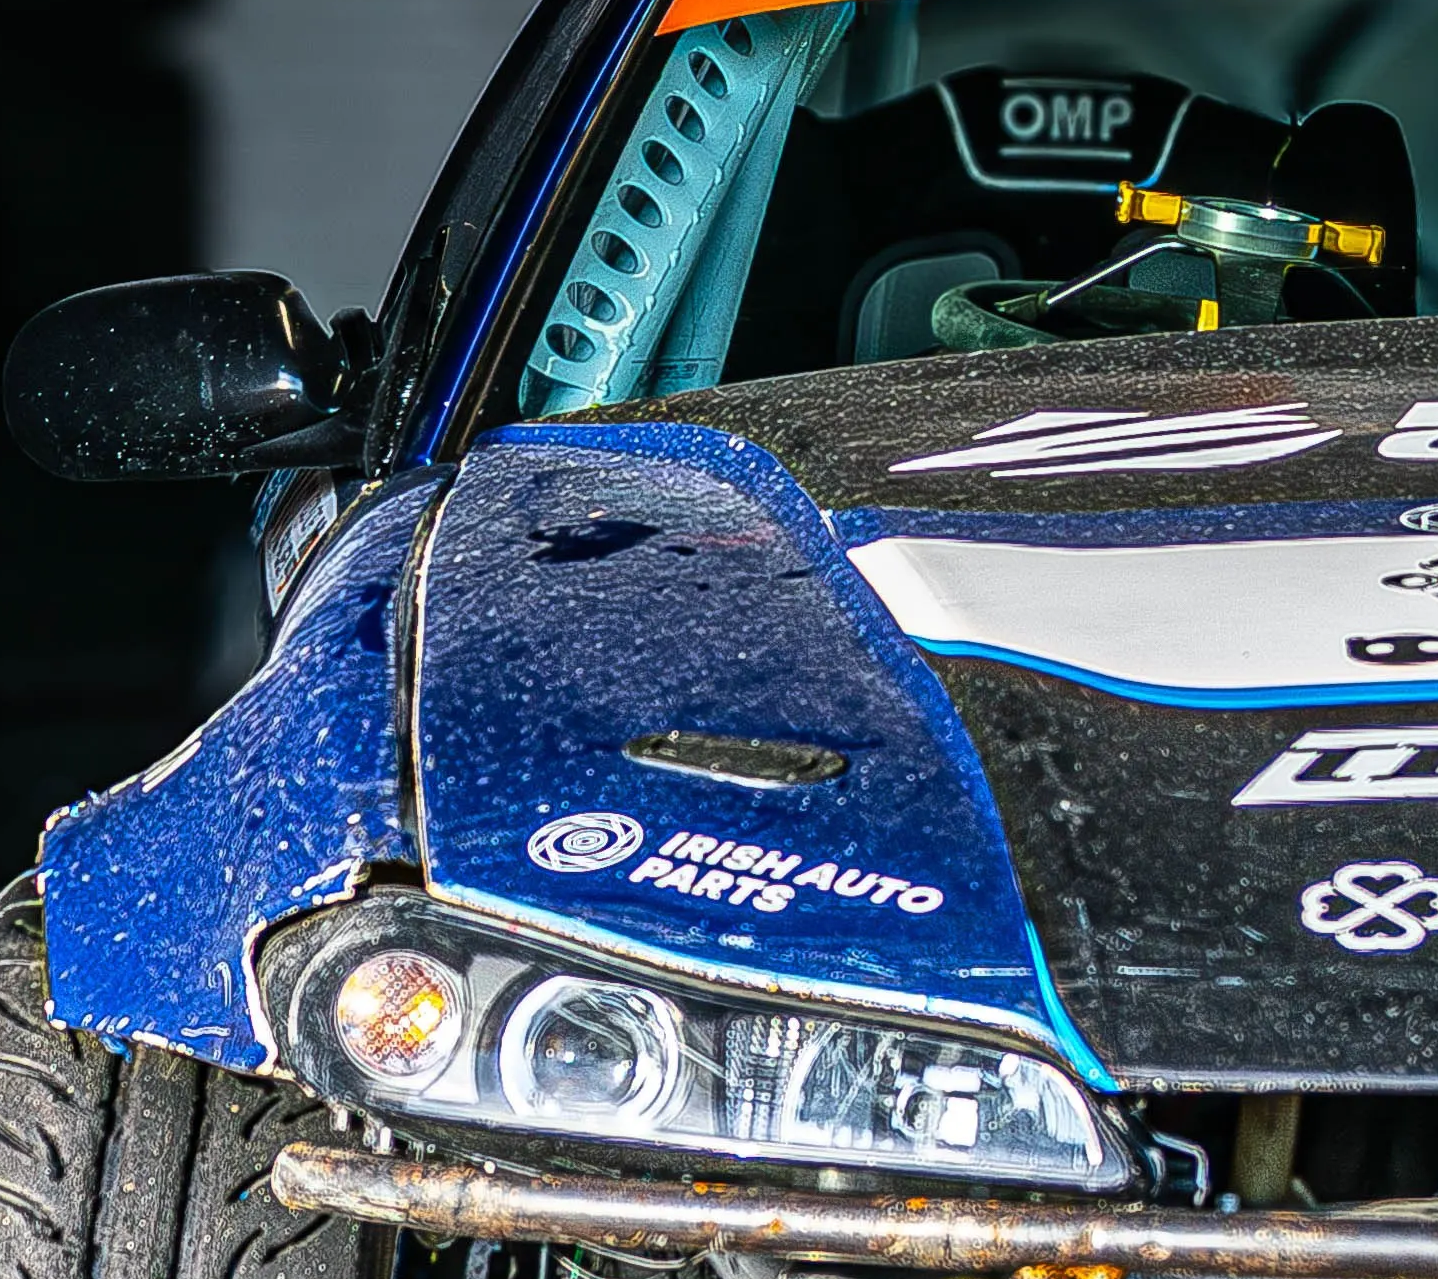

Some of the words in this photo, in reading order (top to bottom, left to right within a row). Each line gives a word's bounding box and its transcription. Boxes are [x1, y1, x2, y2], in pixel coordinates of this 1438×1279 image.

[998, 91, 1136, 144] OMP
[628, 855, 797, 914] PARTS
[657, 830, 804, 881] IRISH
[791, 861, 944, 914] AUTO
